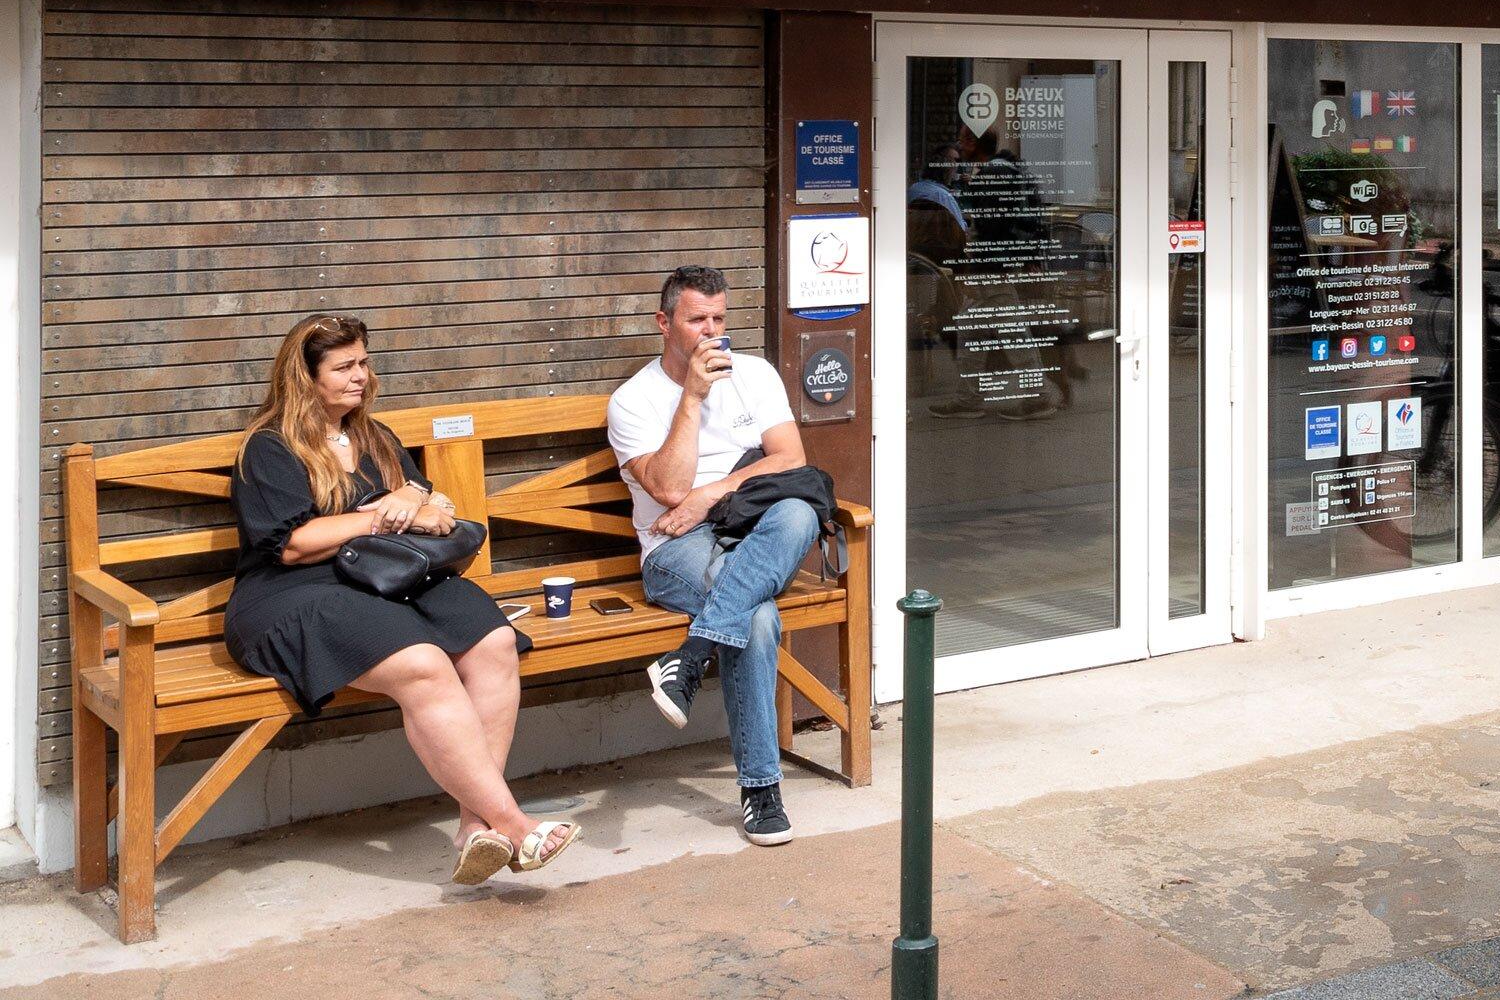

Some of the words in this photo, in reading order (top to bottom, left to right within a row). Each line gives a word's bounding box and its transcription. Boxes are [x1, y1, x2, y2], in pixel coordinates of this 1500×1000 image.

[1005, 87, 1064, 101] BAYEUX
[1005, 104, 1064, 118] BESSIN
[1005, 120, 1064, 131] TOURISME
[813, 135, 843, 143] OFFICE
[801, 146, 812, 154] DE
[814, 146, 855, 154] TOURISME
[812, 155, 844, 165] CLASSÉ
[1297, 268, 1319, 277] Office
[1320, 268, 1329, 276] de
[1330, 265, 1362, 275] tourisme
[1363, 265, 1371, 273] de
[1373, 264, 1397, 275] Bayeux
[1398, 262, 1429, 271] Intercom
[1316, 279, 1362, 289] Arromanches
[1364, 278, 1374, 286] 02
[1374, 278, 1382, 286] 31
[1328, 294, 1353, 304] Bayeux
[1354, 293, 1363, 301] 02
[1371, 292, 1380, 300] 51
[1390, 291, 1400, 299] 28
[1309, 306, 1369, 319] Longues-sur-Mer
[1372, 306, 1382, 314] 02
[1382, 305, 1390, 313] 31
[1390, 305, 1398, 313] 21
[1398, 304, 1408, 312] 46
[1408, 303, 1417, 311] 87
[1311, 321, 1364, 333] Port-en-Bessin
[1366, 320, 1376, 328] 02
[1376, 320, 1384, 328] 31
[1384, 319, 1394, 327] 22
[1394, 318, 1403, 326] 45
[1403, 317, 1413, 326] 80
[815, 360, 842, 374] Hello
[1308, 356, 1419, 373] www.bayeux-bessin-tourisme.com
[1315, 473, 1343, 482] URGENCES
[1346, 469, 1377, 478] EMERGENCY
[1380, 464, 1412, 474] EMERGENCIA
